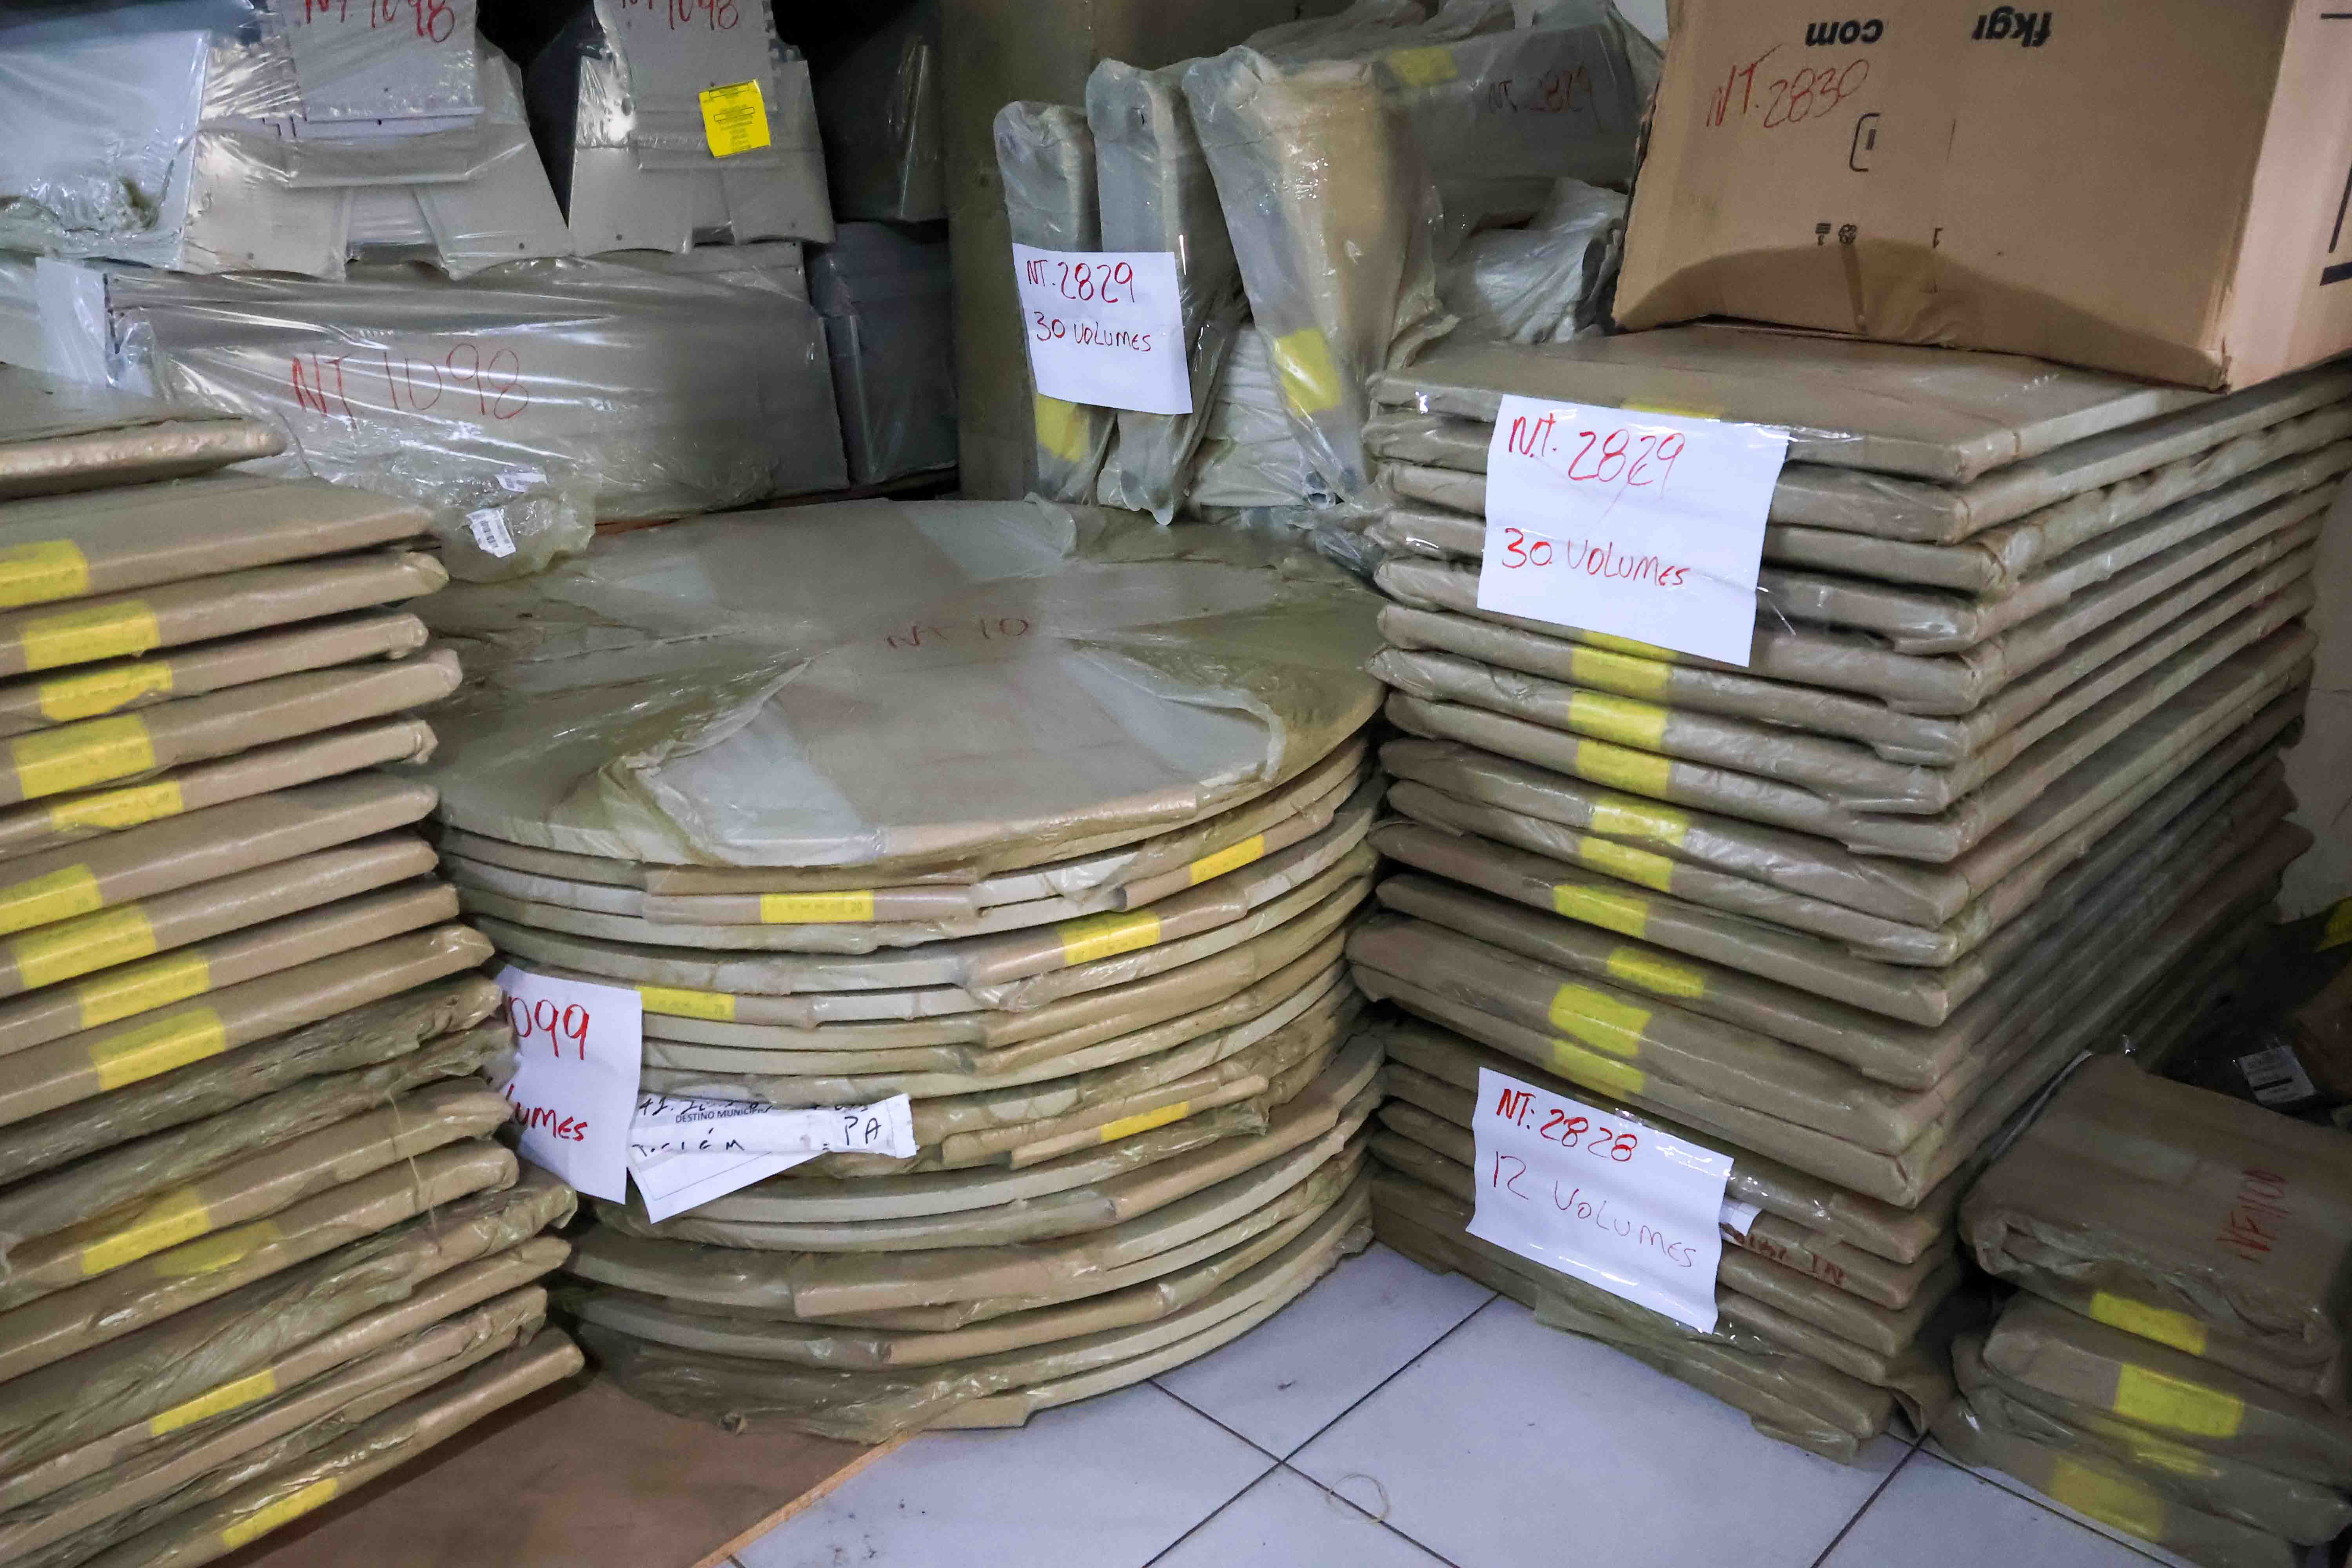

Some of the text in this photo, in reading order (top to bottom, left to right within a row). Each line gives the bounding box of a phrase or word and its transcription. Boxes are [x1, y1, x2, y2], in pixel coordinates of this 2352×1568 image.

[1806, 20, 1883, 47] com
[1034, 311, 1065, 341] 30
[292, 343, 530, 434] NT 1098
[1568, 428, 1686, 499] 2829
[1502, 528, 1553, 569] 30
[506, 997, 590, 1060] 099
[675, 1109, 715, 1123] DESTINO
[1540, 1109, 1638, 1161] 2828
[1493, 1151, 1529, 1200] 12
